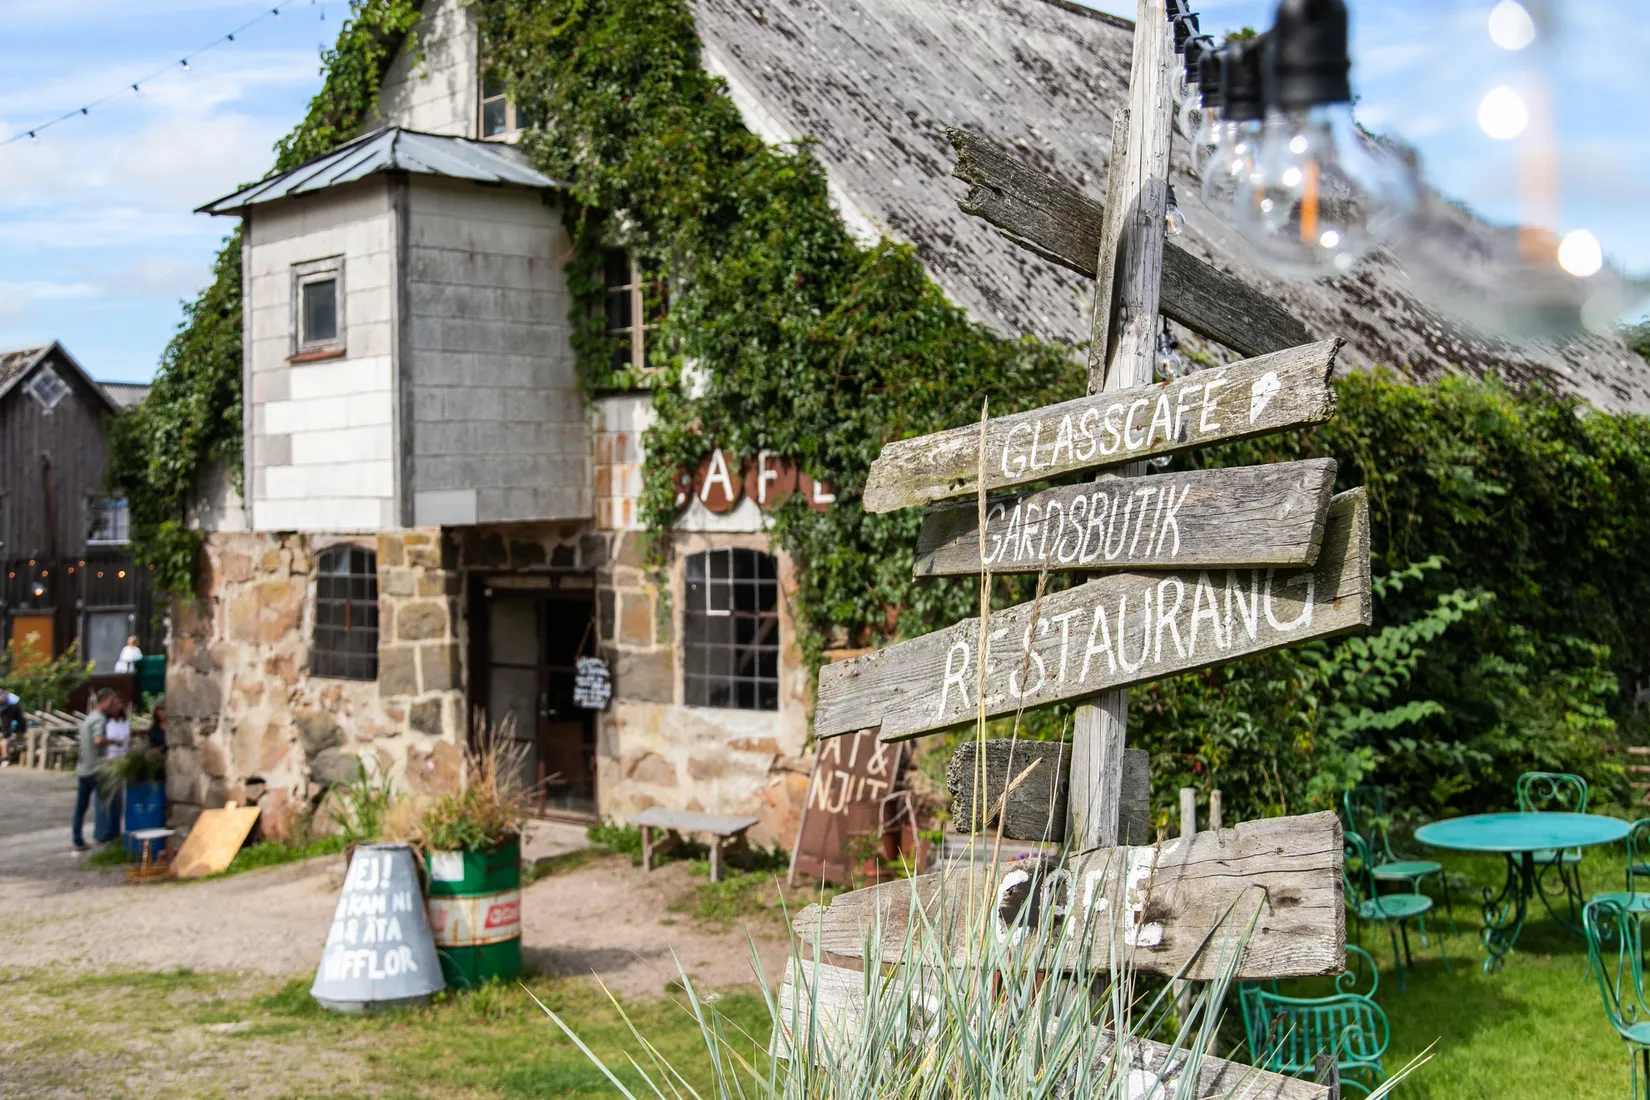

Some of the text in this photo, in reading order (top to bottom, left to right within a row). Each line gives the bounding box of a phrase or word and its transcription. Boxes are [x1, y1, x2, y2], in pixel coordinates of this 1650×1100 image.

[1000, 370, 1227, 479] GLASSCAFÉ
[981, 483, 1191, 565] GÅRDSBUTIK
[937, 568, 1315, 721] RESTAURANG
